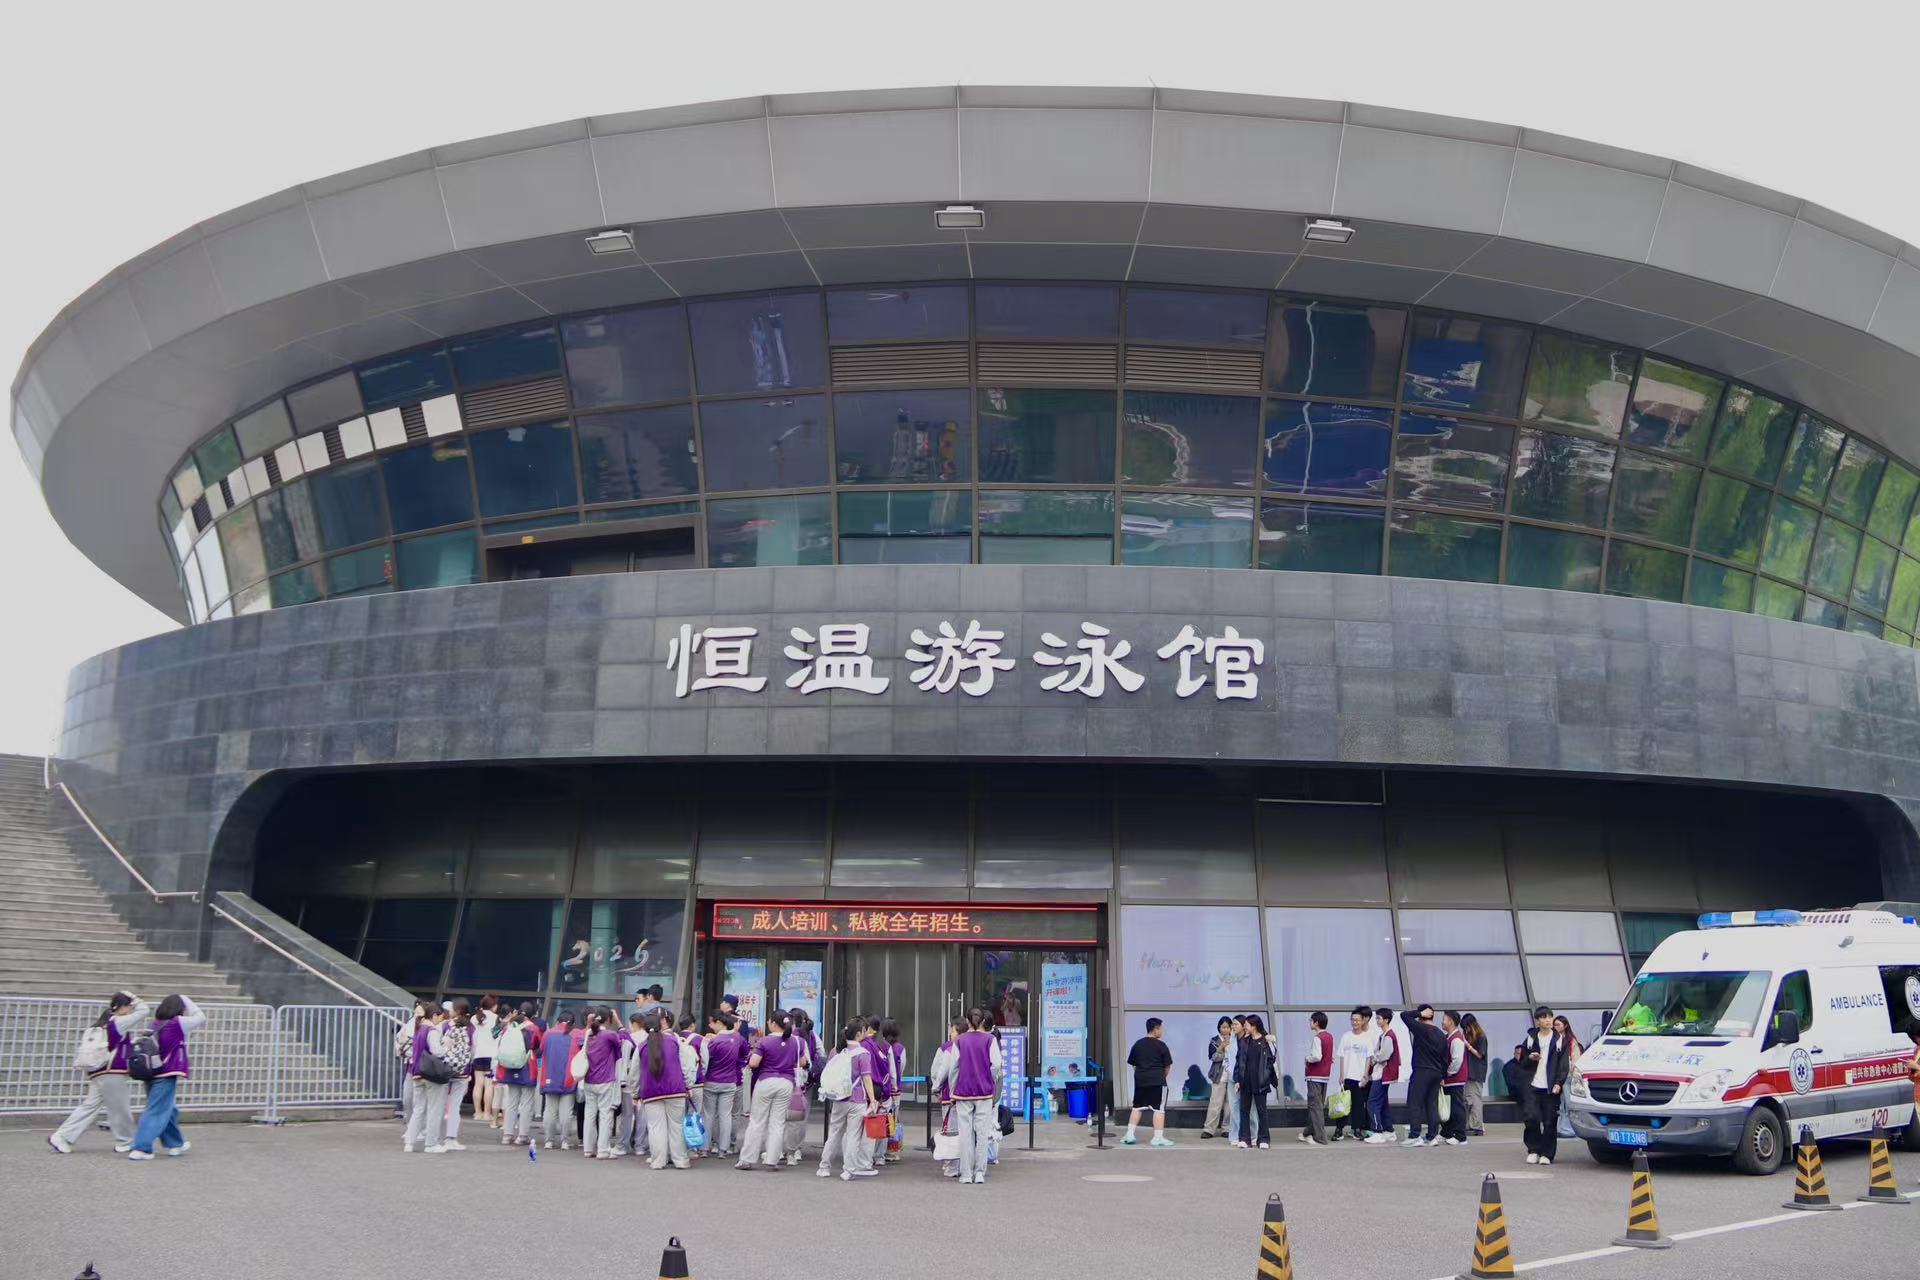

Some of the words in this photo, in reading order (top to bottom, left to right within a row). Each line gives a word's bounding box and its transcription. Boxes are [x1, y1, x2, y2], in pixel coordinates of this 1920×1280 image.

[666, 619, 1266, 700] 恒温游泳馆
[1830, 993, 1885, 1010] AMBULANCE
[1871, 1108, 1890, 1127] 120
